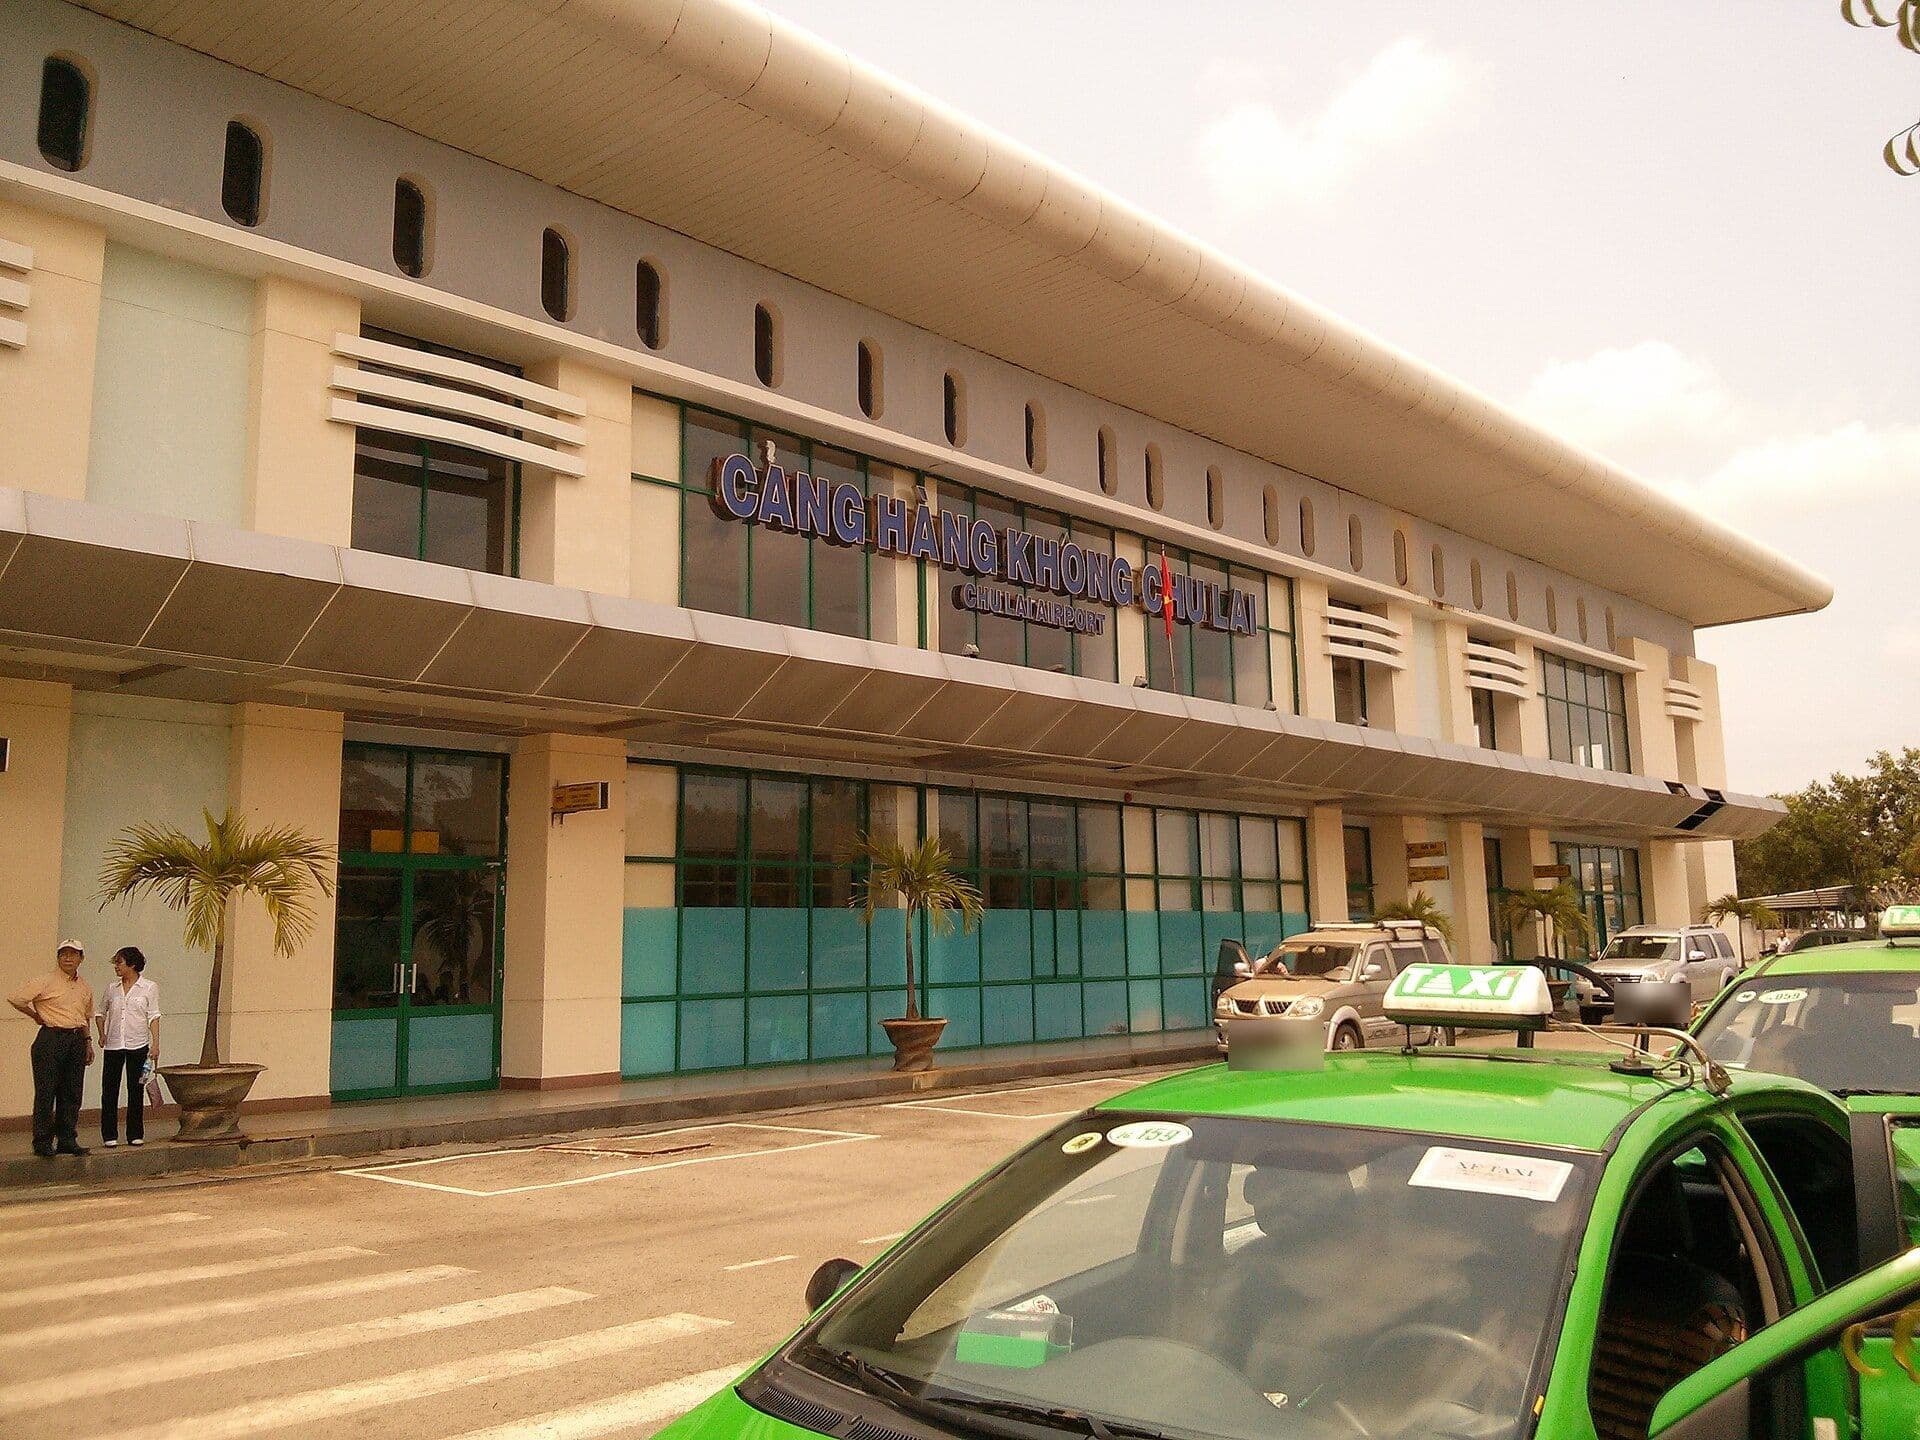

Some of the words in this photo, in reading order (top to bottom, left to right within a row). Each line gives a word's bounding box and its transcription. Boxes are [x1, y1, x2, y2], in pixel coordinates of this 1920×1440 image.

[877, 485, 998, 576] HÀNG
[1006, 527, 1134, 606] KHÔNG
[1141, 563, 1206, 624] CHU
[1211, 583, 1258, 636] LAI
[963, 583, 1002, 613] CHU
[1004, 591, 1034, 619] LAI
[1036, 598, 1106, 635] AIRPORT
